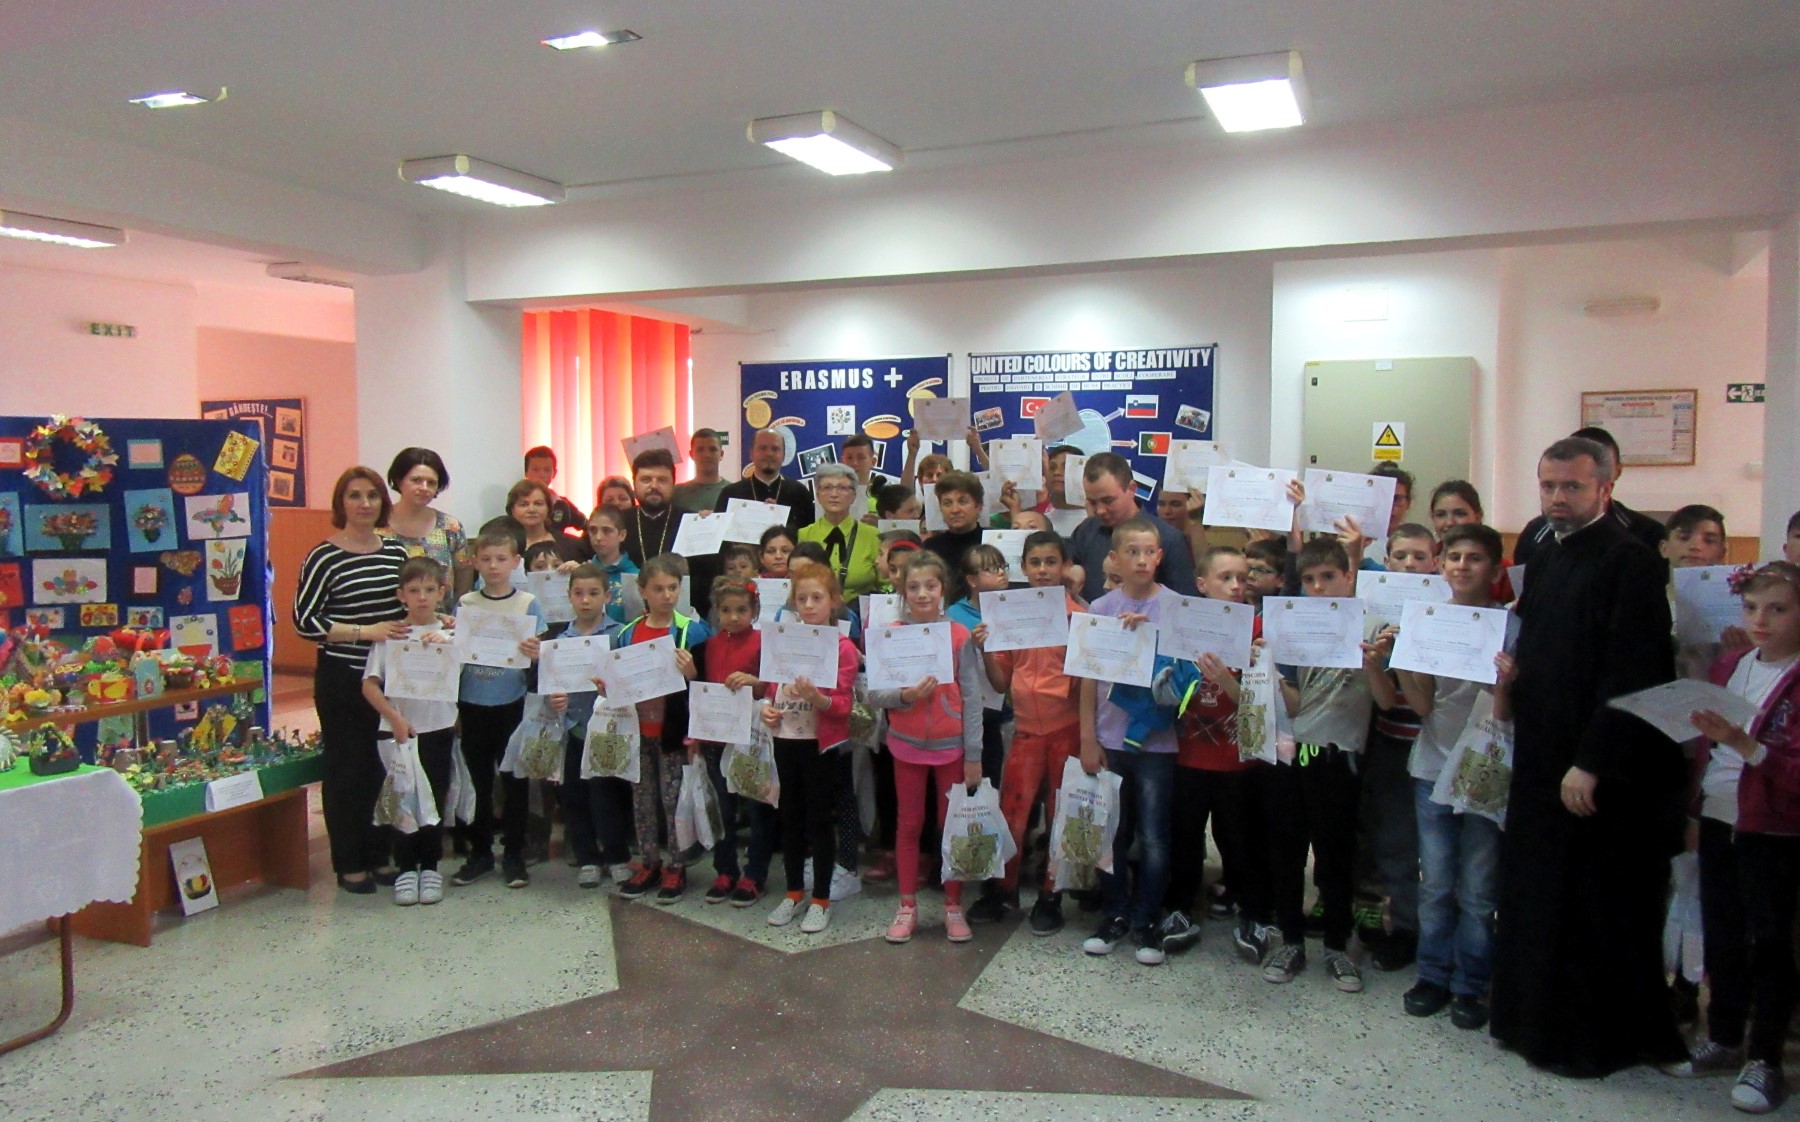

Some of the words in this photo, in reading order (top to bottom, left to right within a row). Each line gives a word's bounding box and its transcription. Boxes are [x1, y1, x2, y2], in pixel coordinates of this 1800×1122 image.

[91, 322, 134, 337] EXIT
[971, 355, 1022, 375] UNITED
[1024, 353, 1091, 373] COLOURS
[1093, 351, 1112, 370] OF
[1115, 348, 1211, 370] CREATIVITY
[780, 368, 873, 391] ERASMUS
[884, 367, 903, 388] +
